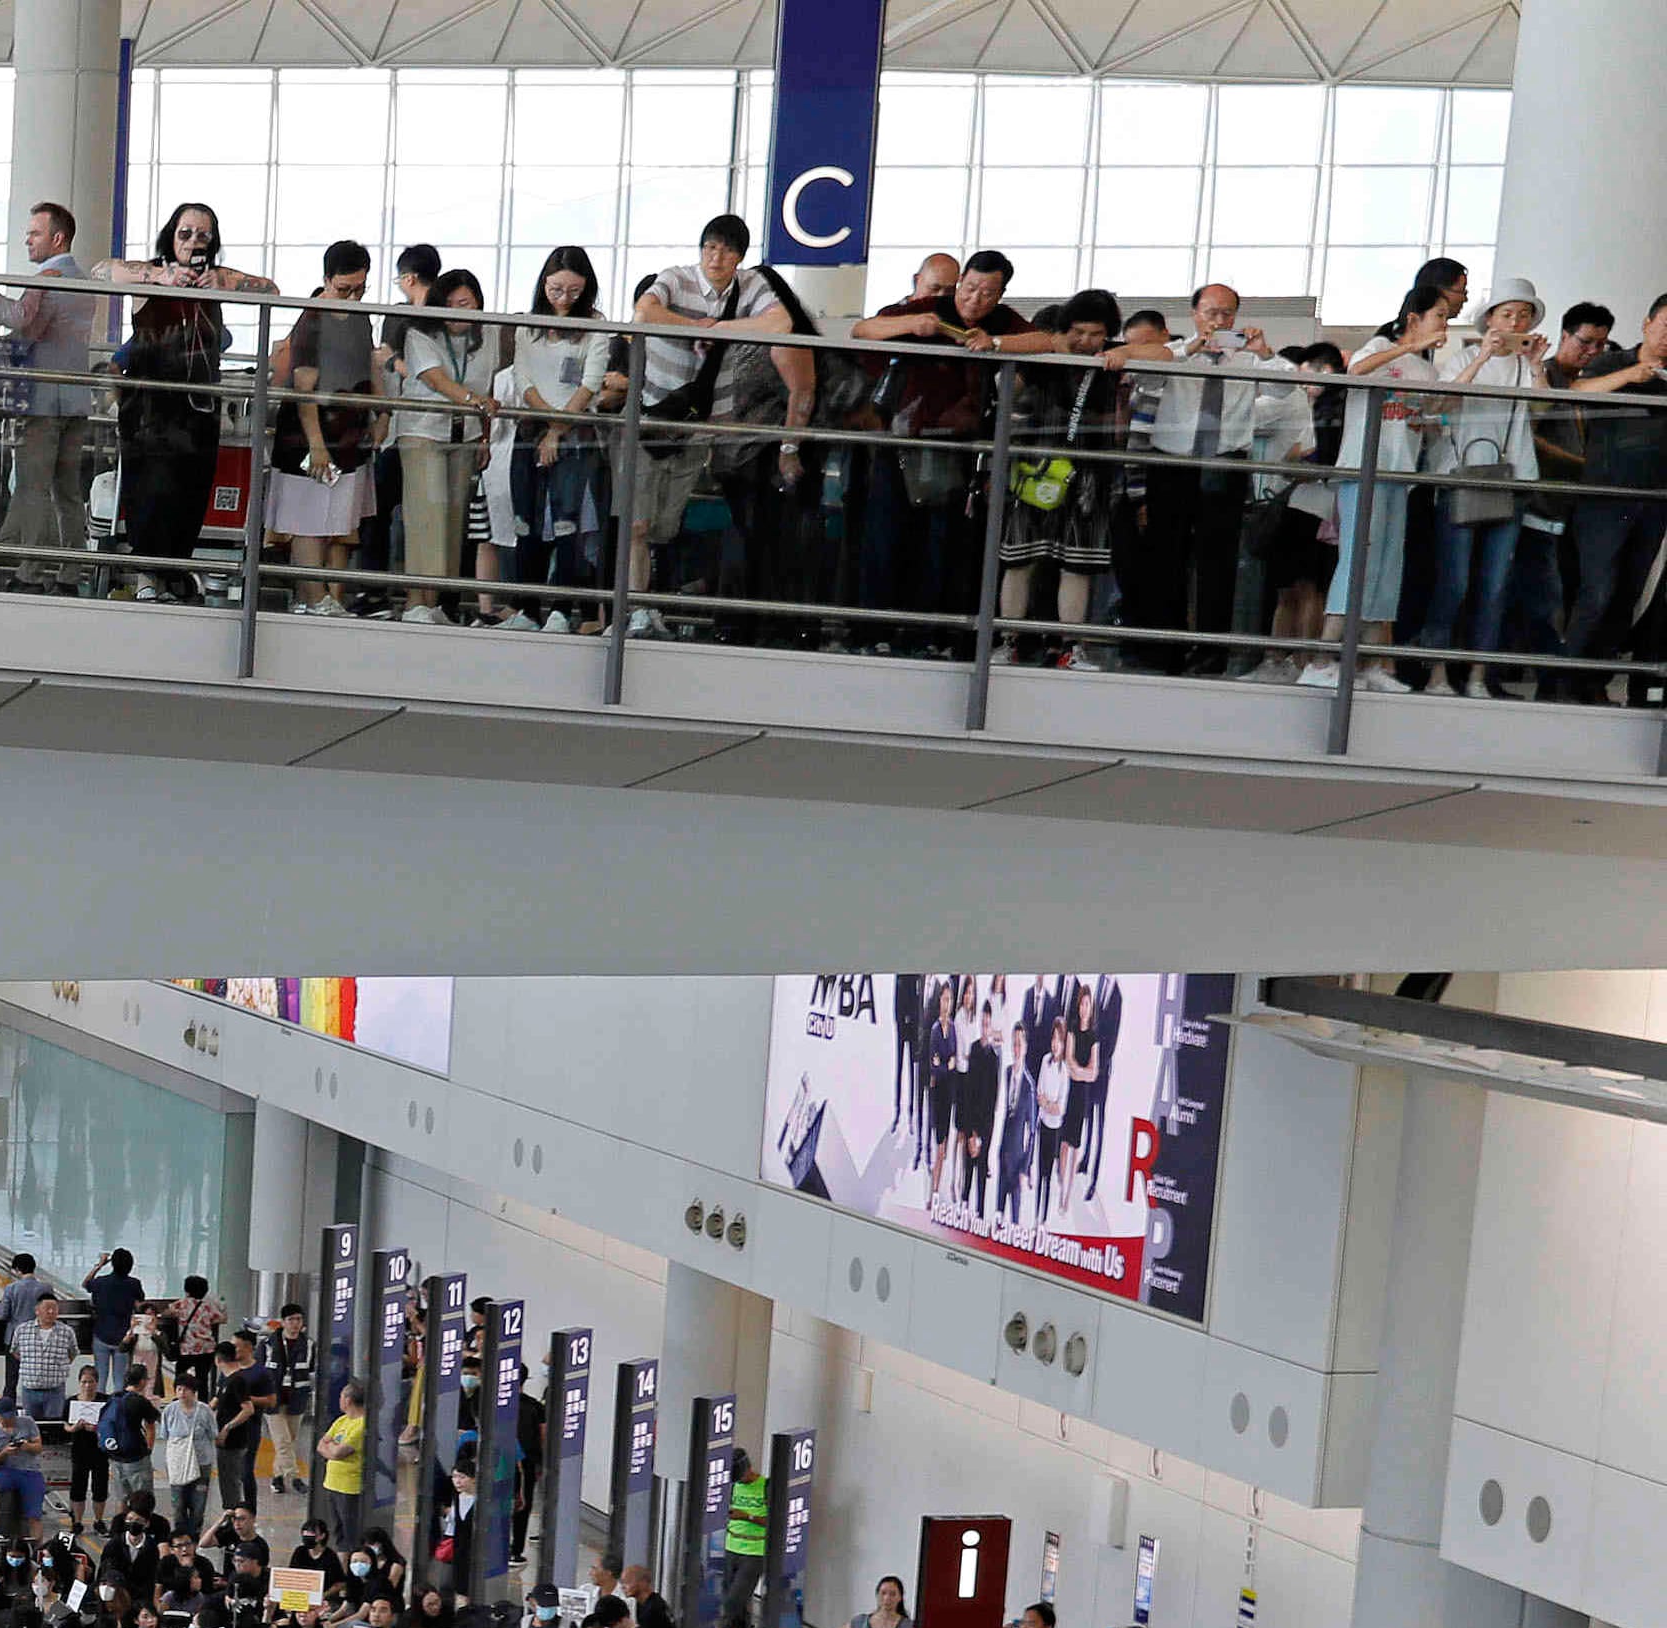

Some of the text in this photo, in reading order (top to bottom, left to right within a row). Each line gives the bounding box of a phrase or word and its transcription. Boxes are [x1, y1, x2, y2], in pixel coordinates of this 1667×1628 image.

[782, 164, 854, 249] C
[809, 974, 877, 1024] MBA
[341, 1232, 352, 1257] 9
[931, 1193, 1125, 1280] Reach Your Career Dream with Us
[388, 1255, 405, 1281] 10
[448, 1281, 463, 1307] 11
[503, 1307, 521, 1336] 12
[570, 1337, 589, 1366] 13
[637, 1368, 655, 1397] 14
[713, 1402, 733, 1433] 15
[793, 1438, 813, 1471] 16
